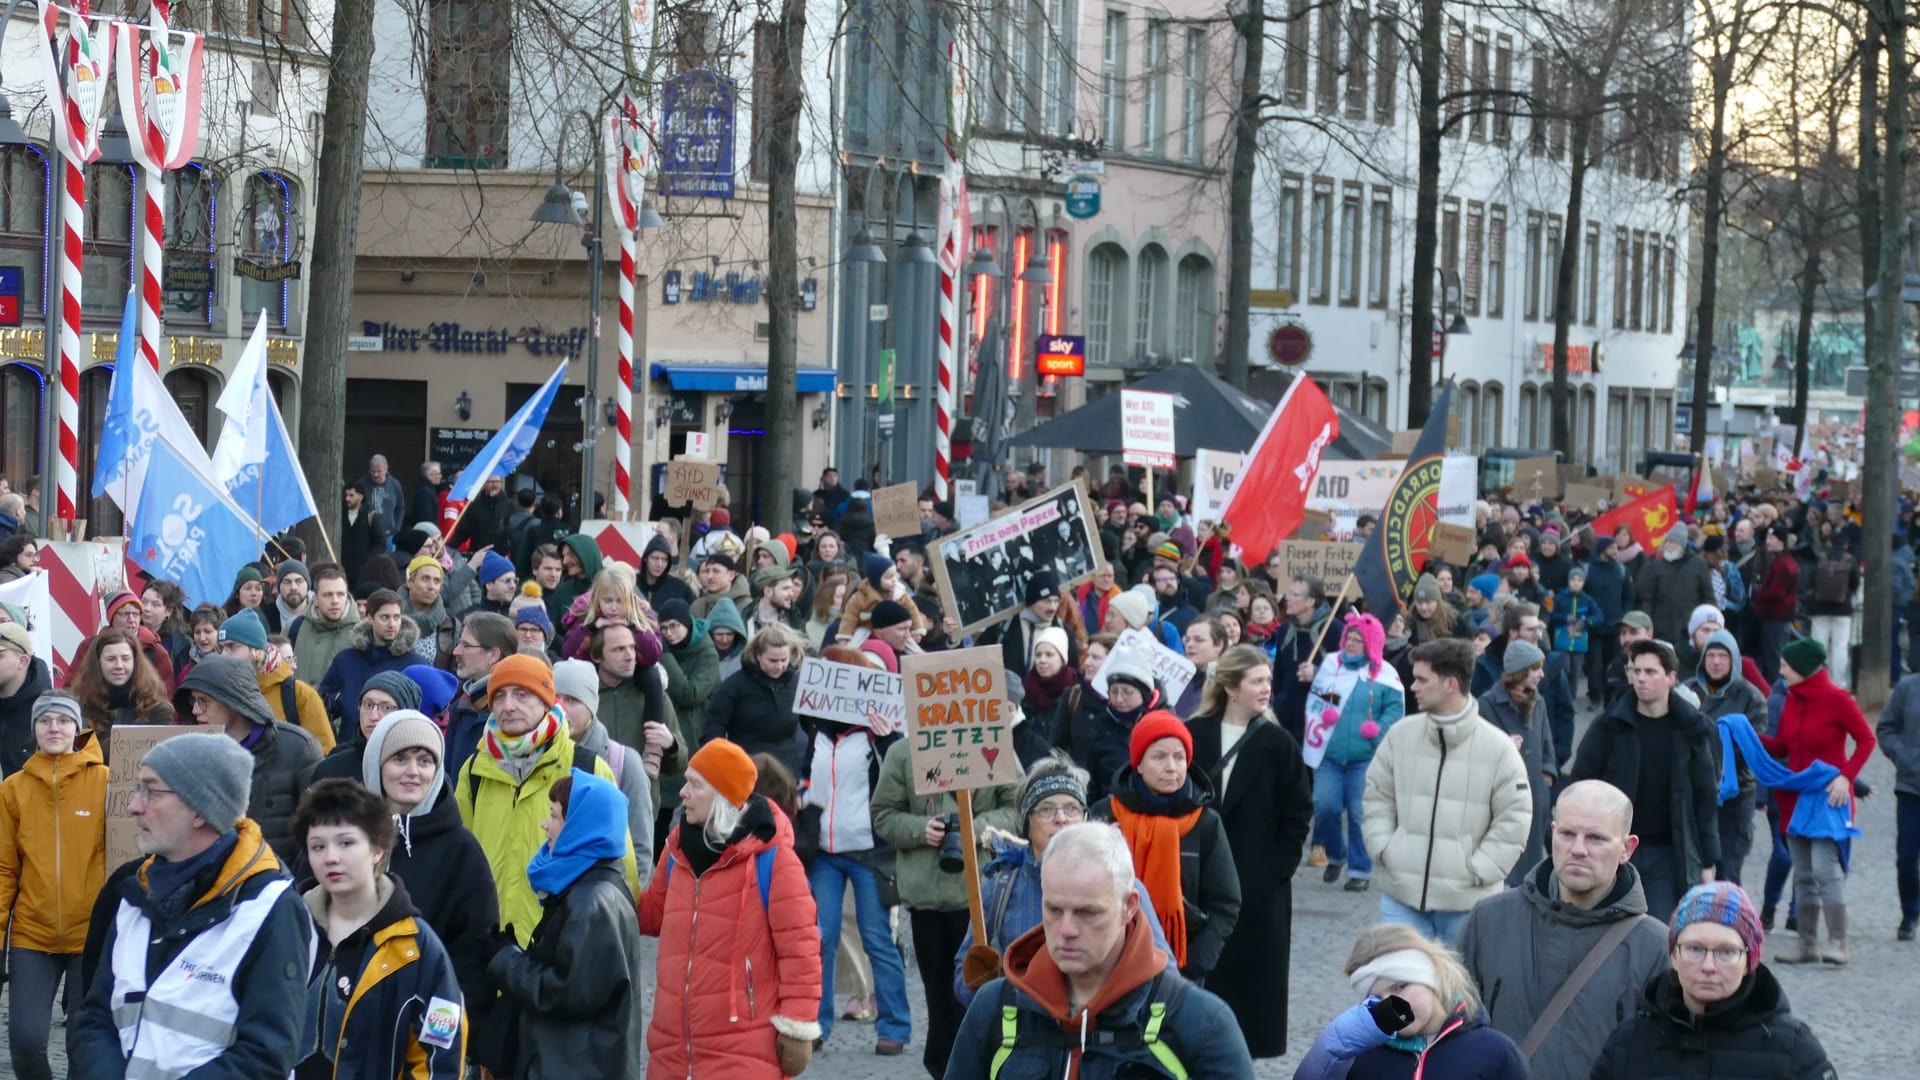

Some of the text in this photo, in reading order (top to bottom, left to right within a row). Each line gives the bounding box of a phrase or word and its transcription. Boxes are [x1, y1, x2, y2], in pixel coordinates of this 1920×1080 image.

[1049, 338, 1074, 354] sky
[1046, 360, 1074, 370] sport
[674, 467, 704, 484] AfD
[1315, 475, 1350, 498] AfD
[674, 486, 713, 503] STINKT
[967, 533, 997, 554] Fritz
[1020, 506, 1055, 532] Papen
[1287, 545, 1354, 560] Fieser Fritz
[1323, 562, 1352, 580] frisch
[806, 662, 850, 690] DIE
[916, 668, 992, 698] DEMO
[800, 689, 905, 718] KUNTERBUN
[918, 699, 1002, 728] KRATIE
[917, 726, 1004, 751] JETZT
